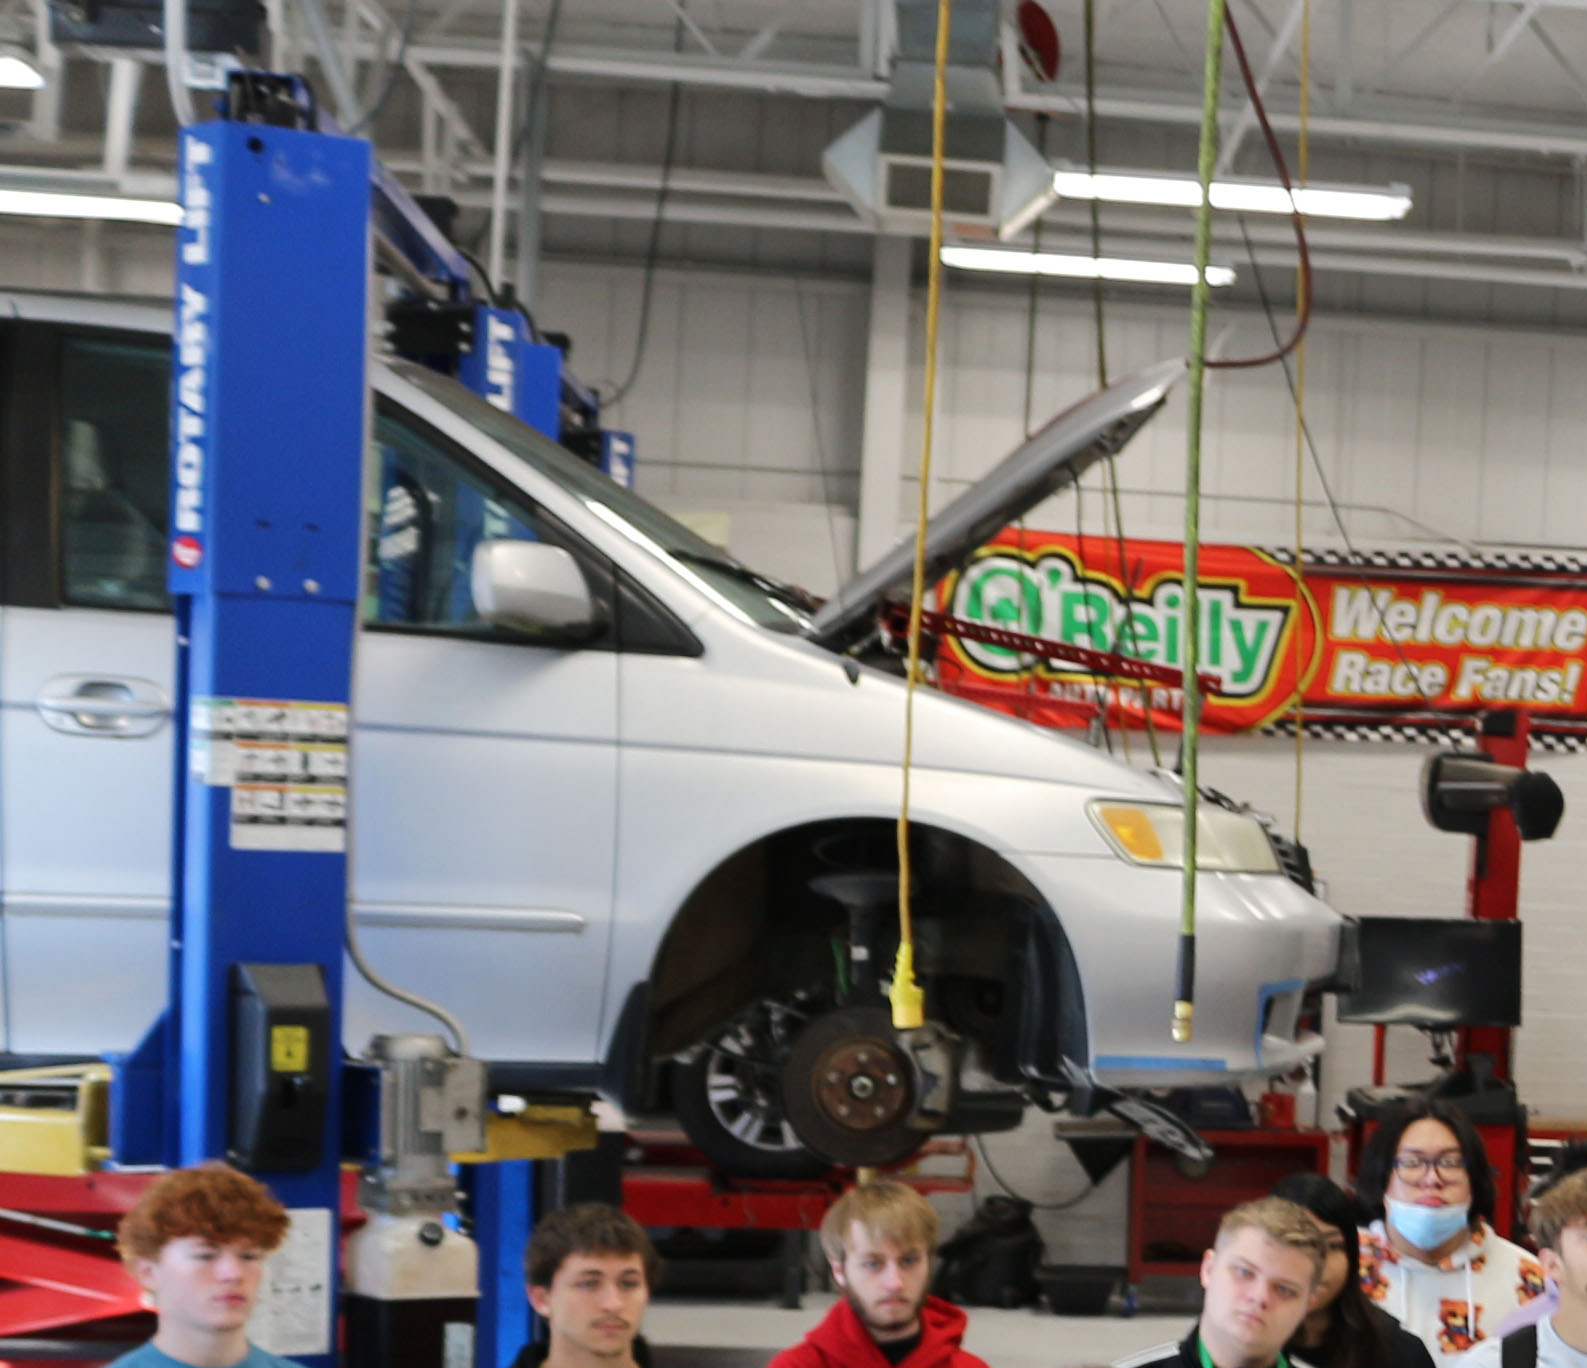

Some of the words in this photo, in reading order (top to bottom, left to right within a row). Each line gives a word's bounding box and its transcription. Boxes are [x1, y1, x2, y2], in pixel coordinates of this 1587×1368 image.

[182, 134, 213, 264] LIFT
[175, 283, 209, 532] ROTARY
[966, 567, 1270, 684] O'Reily
[1330, 650, 1448, 697] Race
[1454, 657, 1582, 703] Fans!
[1119, 685, 1184, 711] PART
